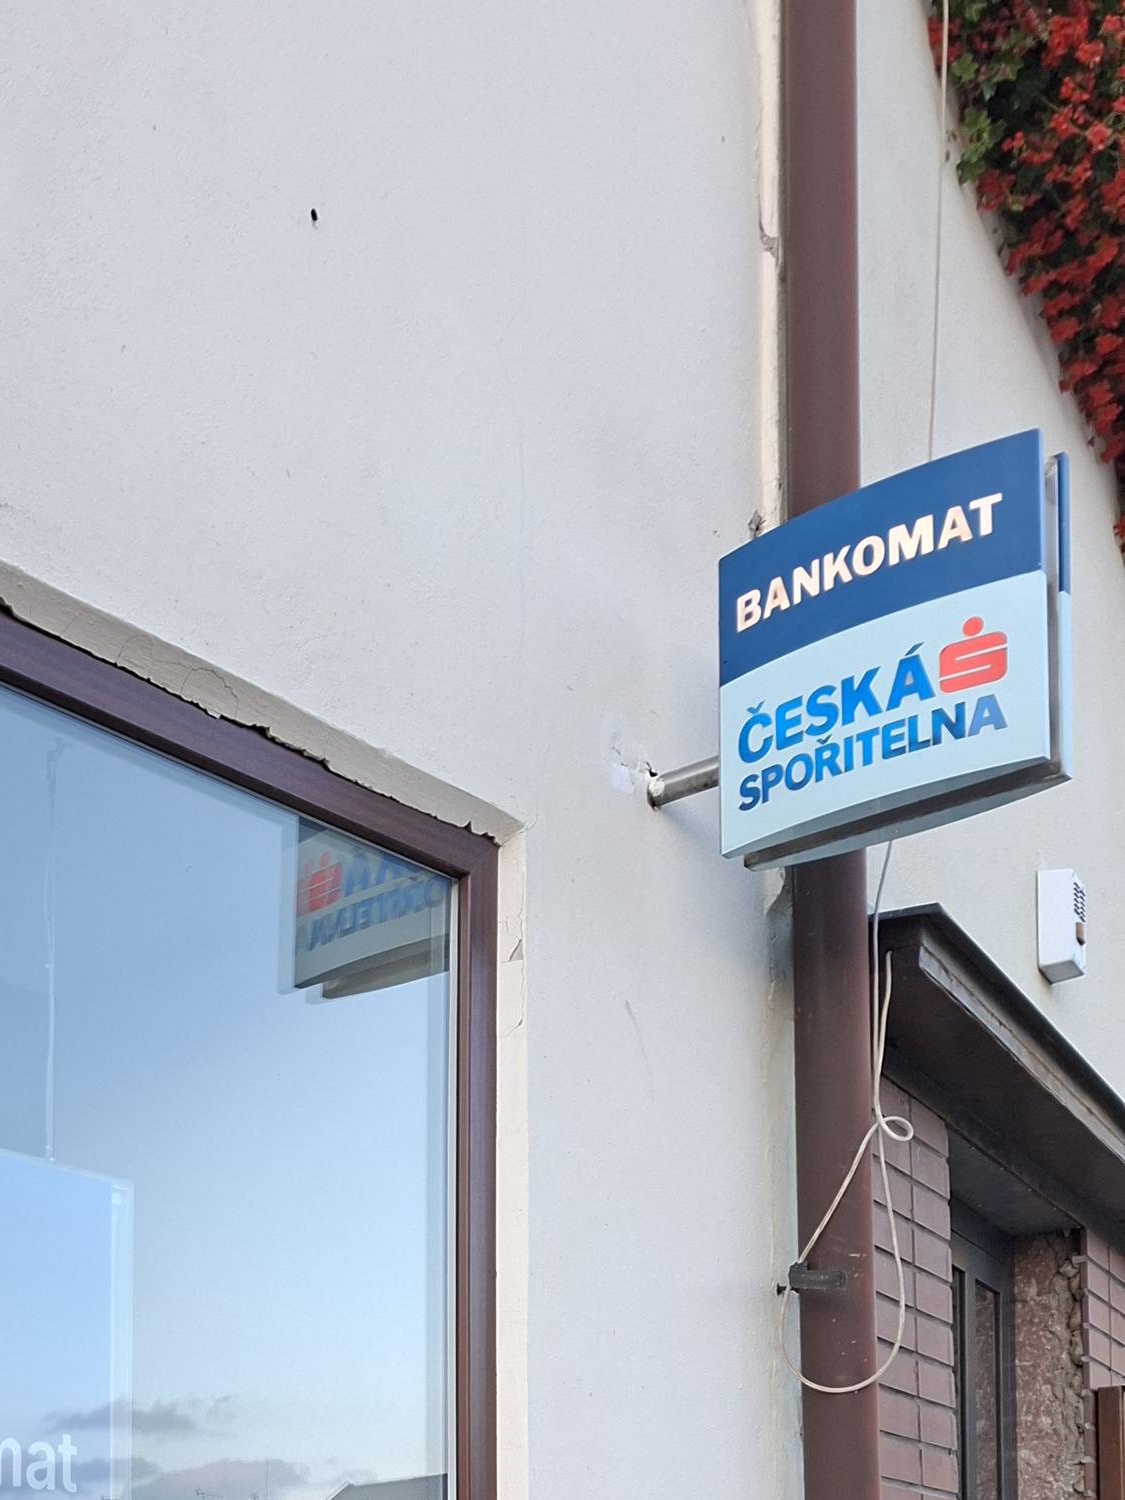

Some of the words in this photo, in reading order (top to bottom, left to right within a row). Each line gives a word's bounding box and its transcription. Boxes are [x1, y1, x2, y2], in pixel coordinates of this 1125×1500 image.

[736, 493, 1003, 633] BANKOMAT
[738, 641, 936, 764] ČESKÁ
[738, 693, 1008, 812] SPOŘITELNA
